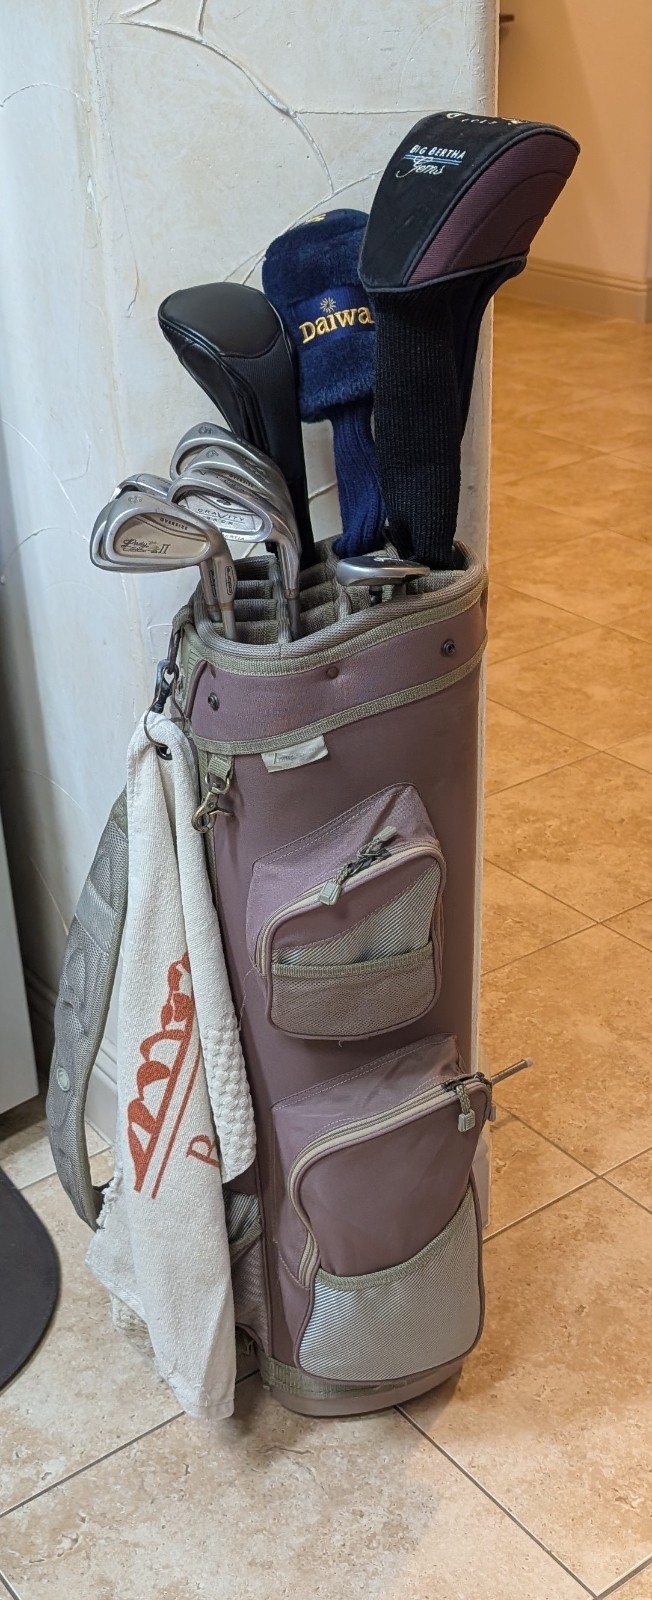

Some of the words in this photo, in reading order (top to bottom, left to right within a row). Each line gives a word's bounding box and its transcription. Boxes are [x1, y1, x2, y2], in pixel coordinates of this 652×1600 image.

[409, 144, 428, 155] BIG
[428, 146, 467, 160] BERTHA
[395, 156, 446, 178] Gems
[298, 306, 376, 344] Daiwa
[197, 508, 245, 521] GRAVITY
[160, 517, 189, 531] OVERSIZE
